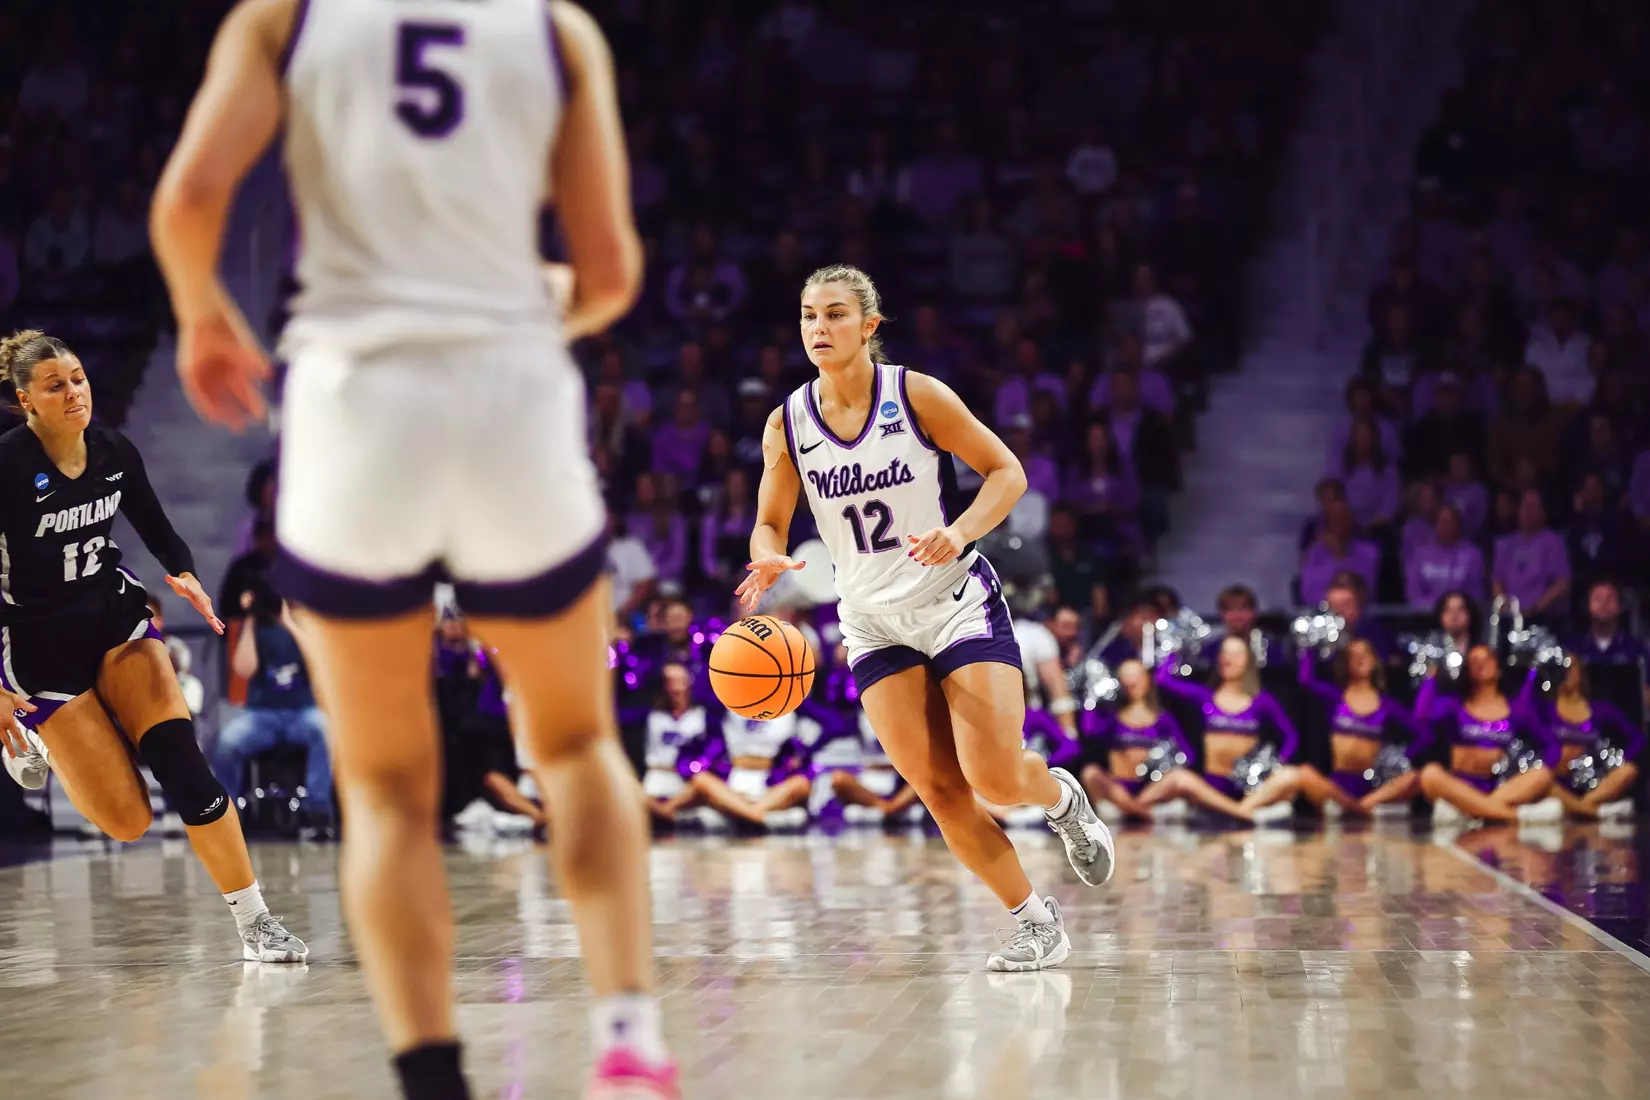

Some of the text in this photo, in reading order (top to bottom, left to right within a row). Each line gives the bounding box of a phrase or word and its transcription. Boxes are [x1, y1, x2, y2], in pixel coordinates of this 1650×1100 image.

[393, 19, 466, 140] 5
[879, 420, 906, 438] XII
[808, 457, 915, 499] Wildcats
[34, 490, 122, 537] PORTLAND
[841, 499, 902, 554] 12
[62, 536, 106, 582] 12
